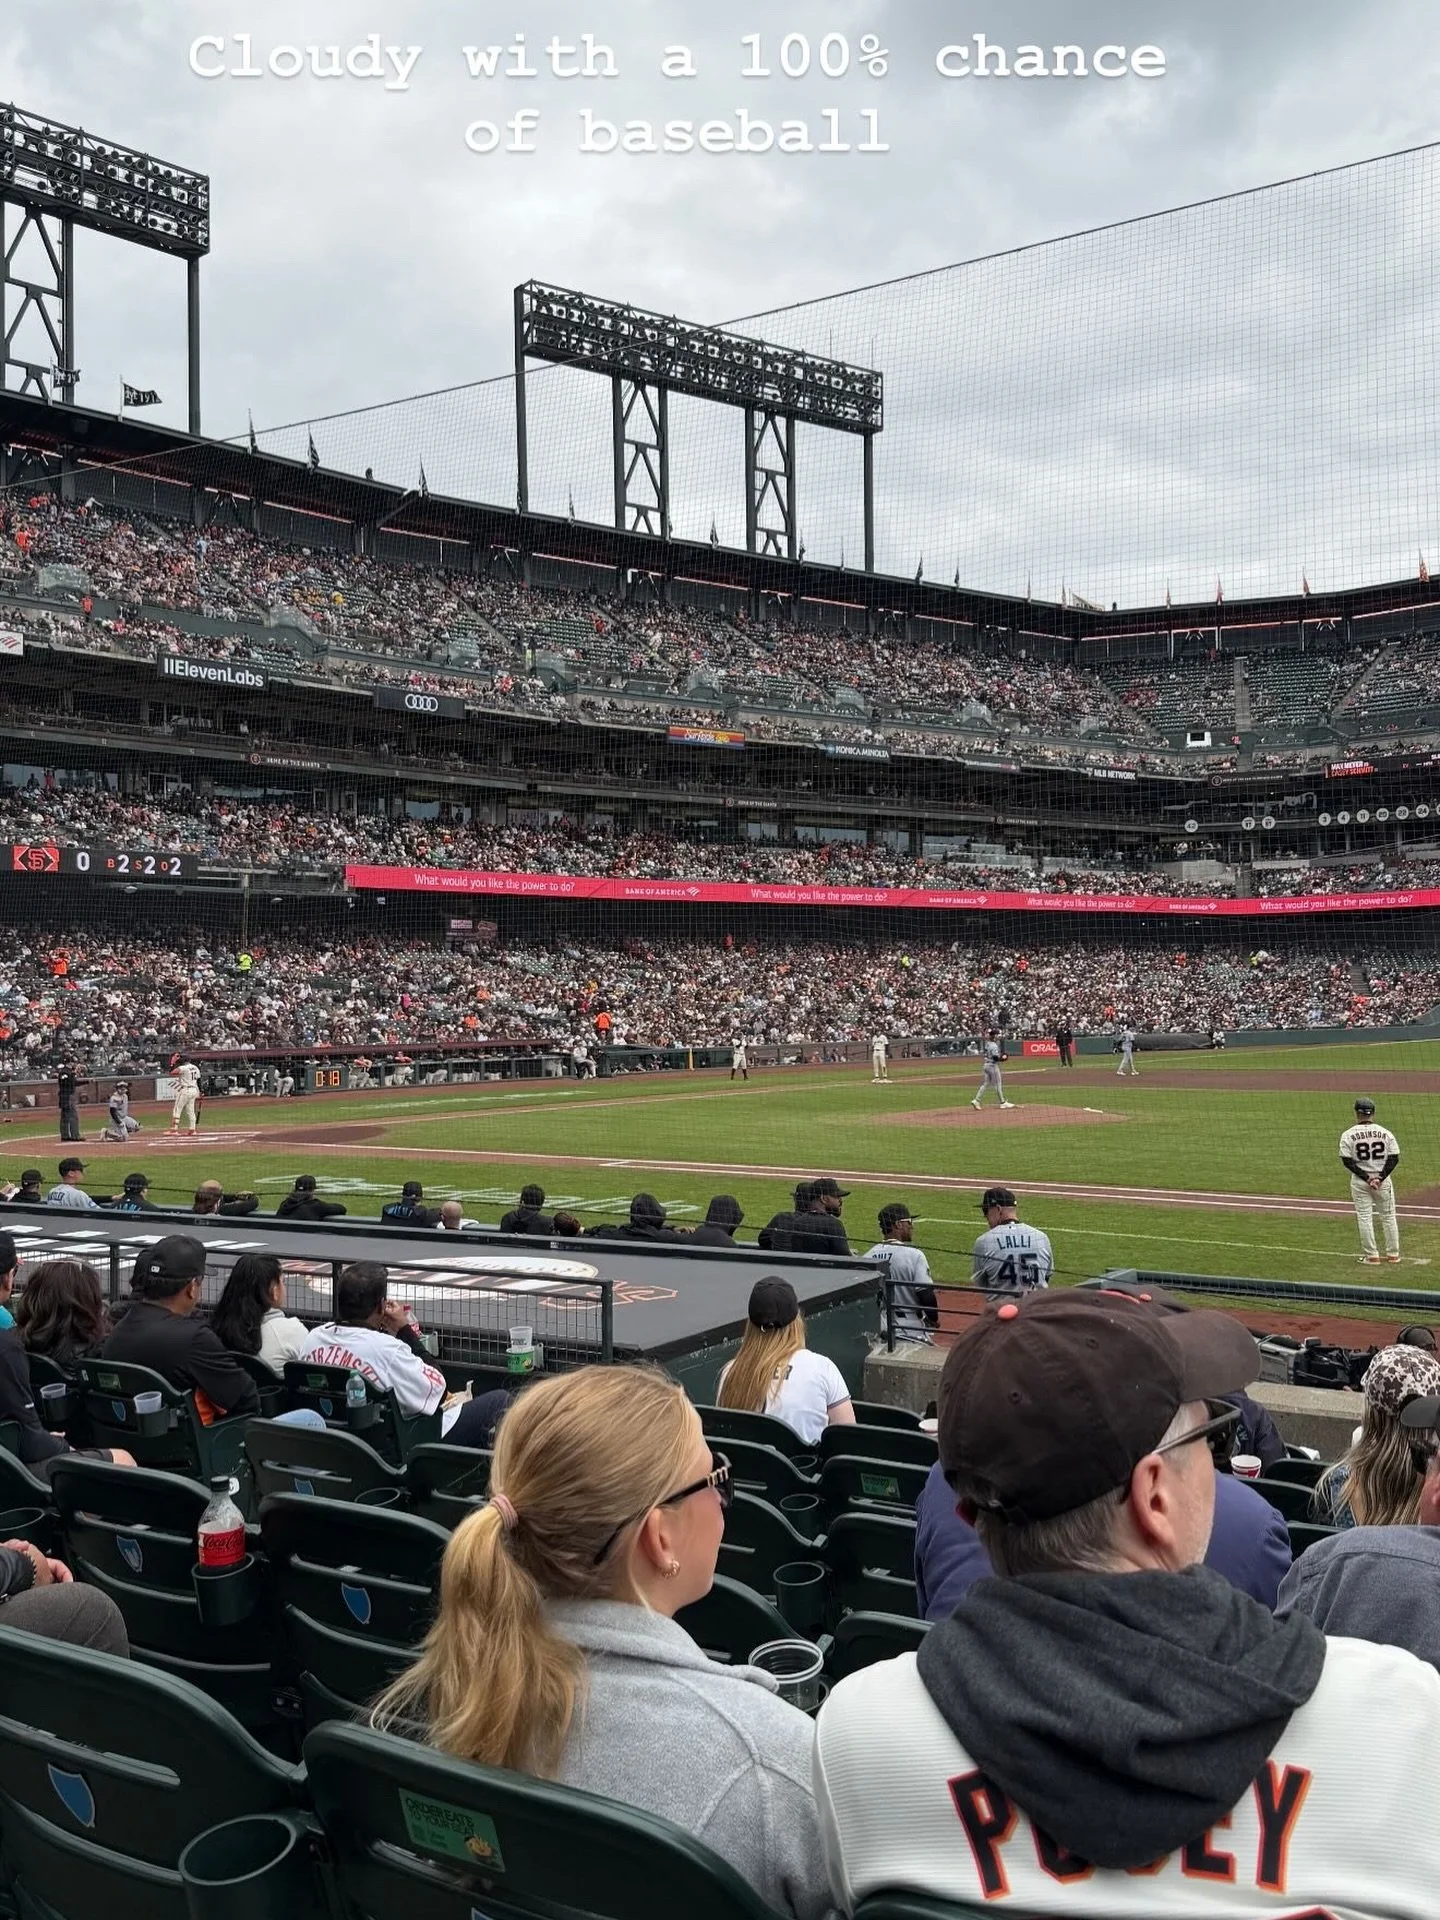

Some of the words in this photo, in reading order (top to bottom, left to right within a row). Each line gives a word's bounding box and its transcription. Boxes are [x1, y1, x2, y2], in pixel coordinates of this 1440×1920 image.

[835, 745, 860, 756] KONICA
[77, 852, 90, 871] 0
[117, 854, 130, 873] 2
[135, 859, 142, 870] S
[144, 856, 156, 874] 2
[170, 857, 182, 876] 2
[414, 874, 439, 886] What
[441, 876, 468, 887] would
[470, 878, 486, 889] you
[488, 877, 503, 888] like
[505, 879, 520, 889] the
[522, 881, 547, 891] power
[549, 881, 559, 890] to
[561, 881, 576, 891] do?
[751, 889, 771, 899] What
[773, 890, 796, 900] would
[798, 893, 813, 902] you
[815, 891, 827, 900] like
[828, 891, 840, 900] the
[841, 893, 864, 903] power
[865, 893, 873, 901] to
[874, 893, 888, 902] do?
[1260, 901, 1283, 910] What
[1284, 900, 1309, 909] would
[1310, 901, 1325, 910] you
[1327, 898, 1341, 908] like
[1343, 897, 1357, 906] the
[1358, 897, 1385, 909] power
[1386, 896, 1395, 905] to
[1397, 895, 1413, 904] do?
[1355, 1141, 1386, 1161] 82
[996, 1235, 1031, 1250] LALLI
[999, 1252, 1039, 1286] 45
